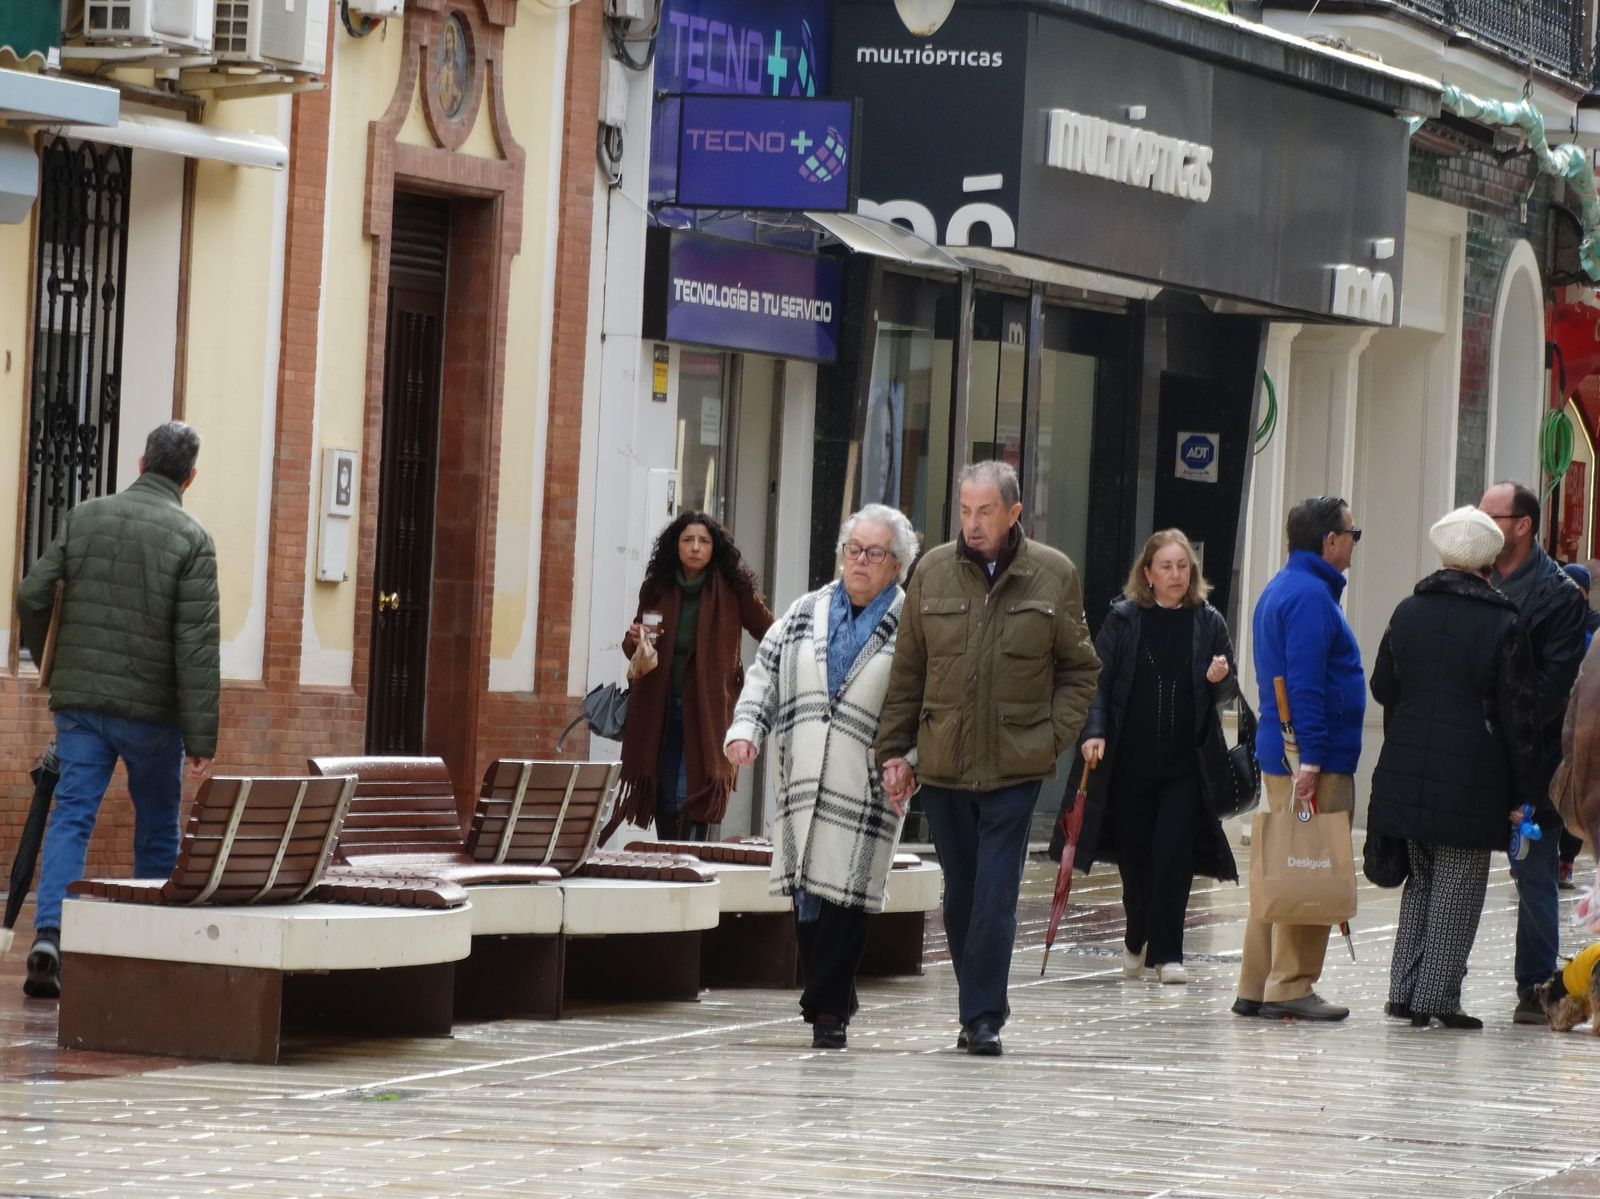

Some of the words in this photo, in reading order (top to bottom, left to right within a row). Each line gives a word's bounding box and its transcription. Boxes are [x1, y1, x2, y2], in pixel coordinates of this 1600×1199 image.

[762, 292, 780, 316] TU
[781, 295, 832, 323] SERVICIO
[1186, 446, 1210, 460] ADT
